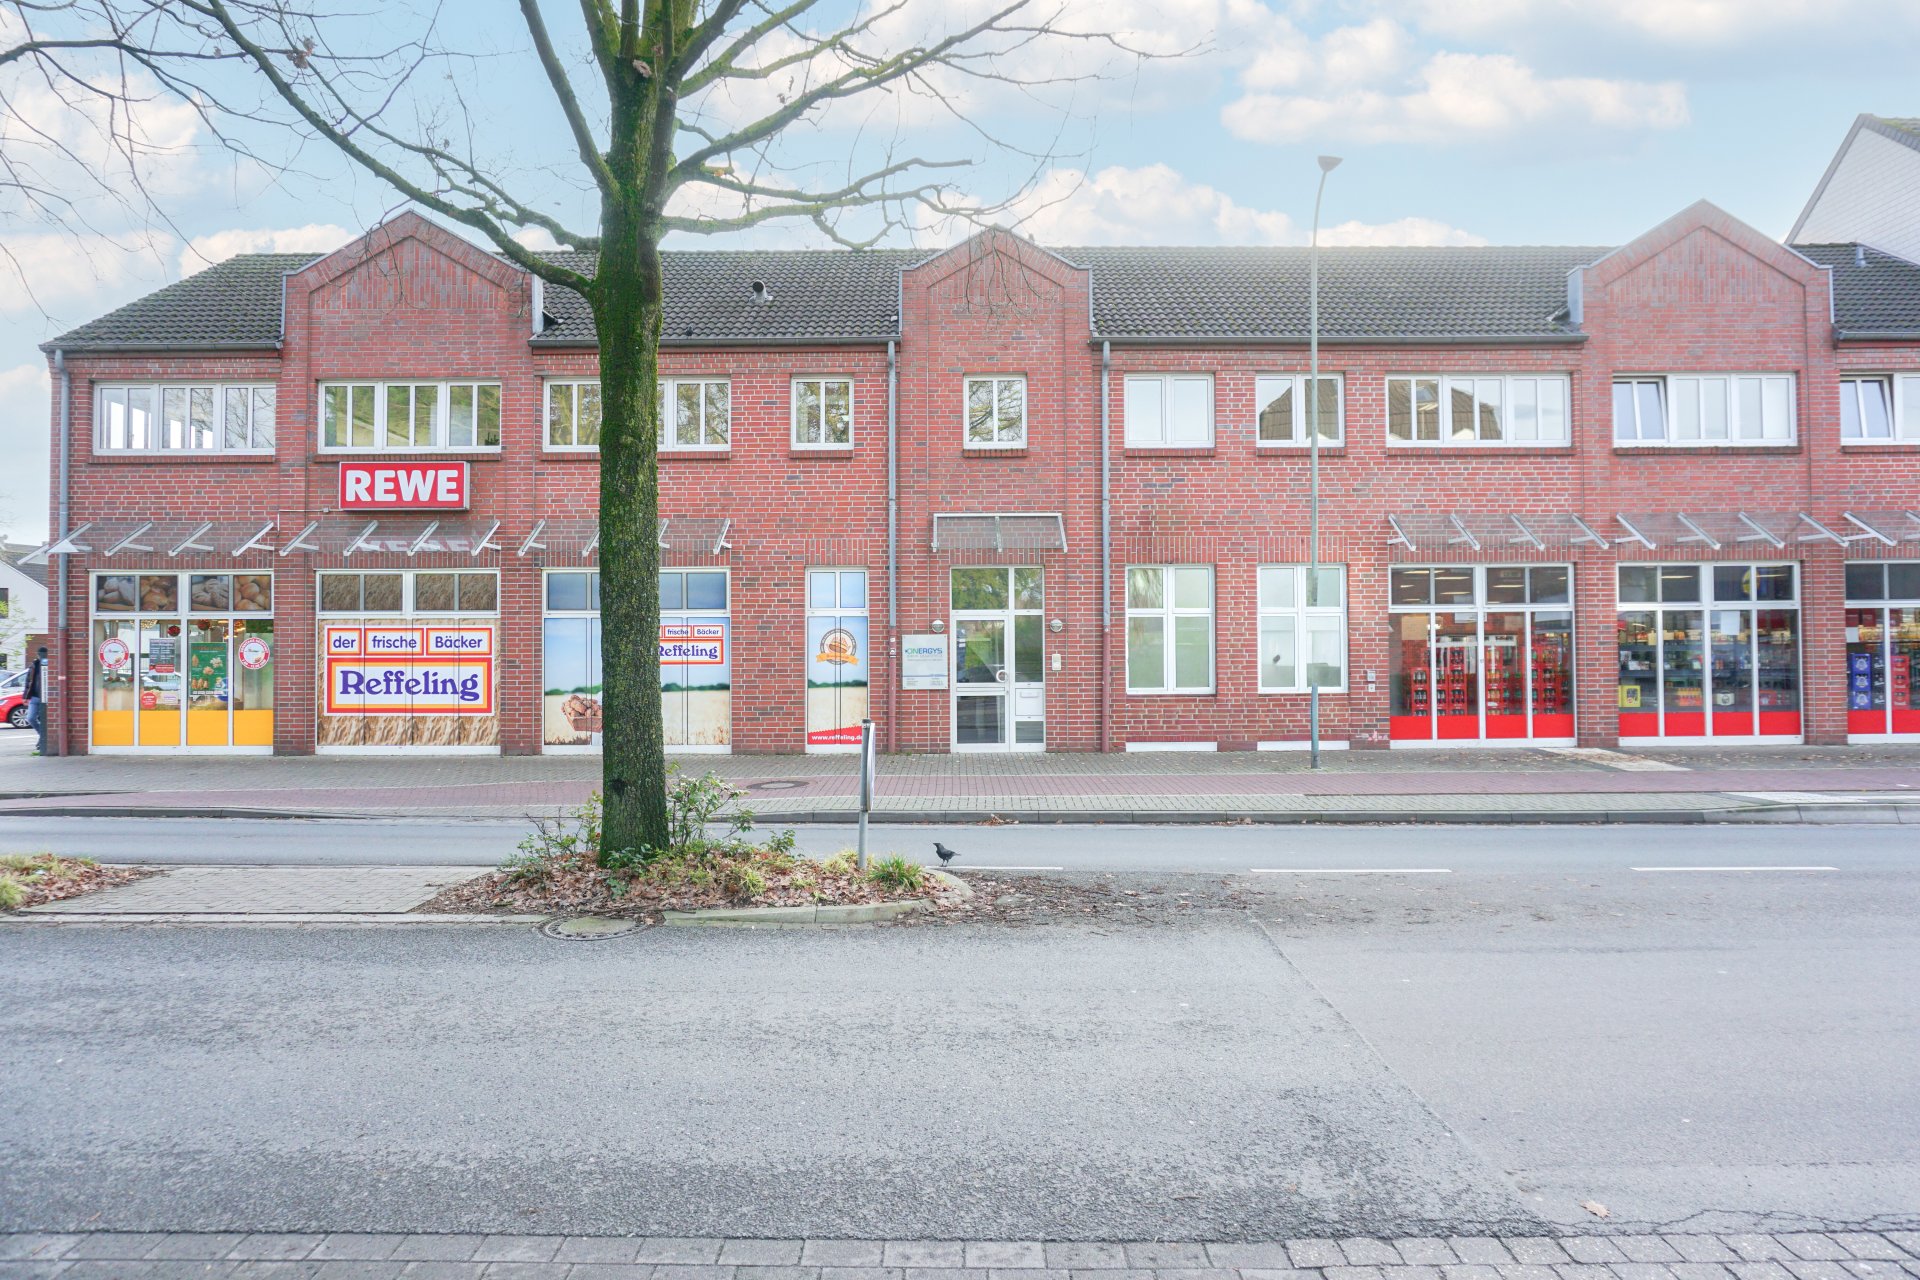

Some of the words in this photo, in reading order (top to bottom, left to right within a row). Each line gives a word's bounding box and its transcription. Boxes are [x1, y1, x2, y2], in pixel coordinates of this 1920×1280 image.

[345, 469, 459, 502] REWE
[333, 635, 356, 648] der
[372, 635, 417, 648] frische
[435, 635, 483, 648] Bäcker
[339, 670, 479, 701] Reffeling
